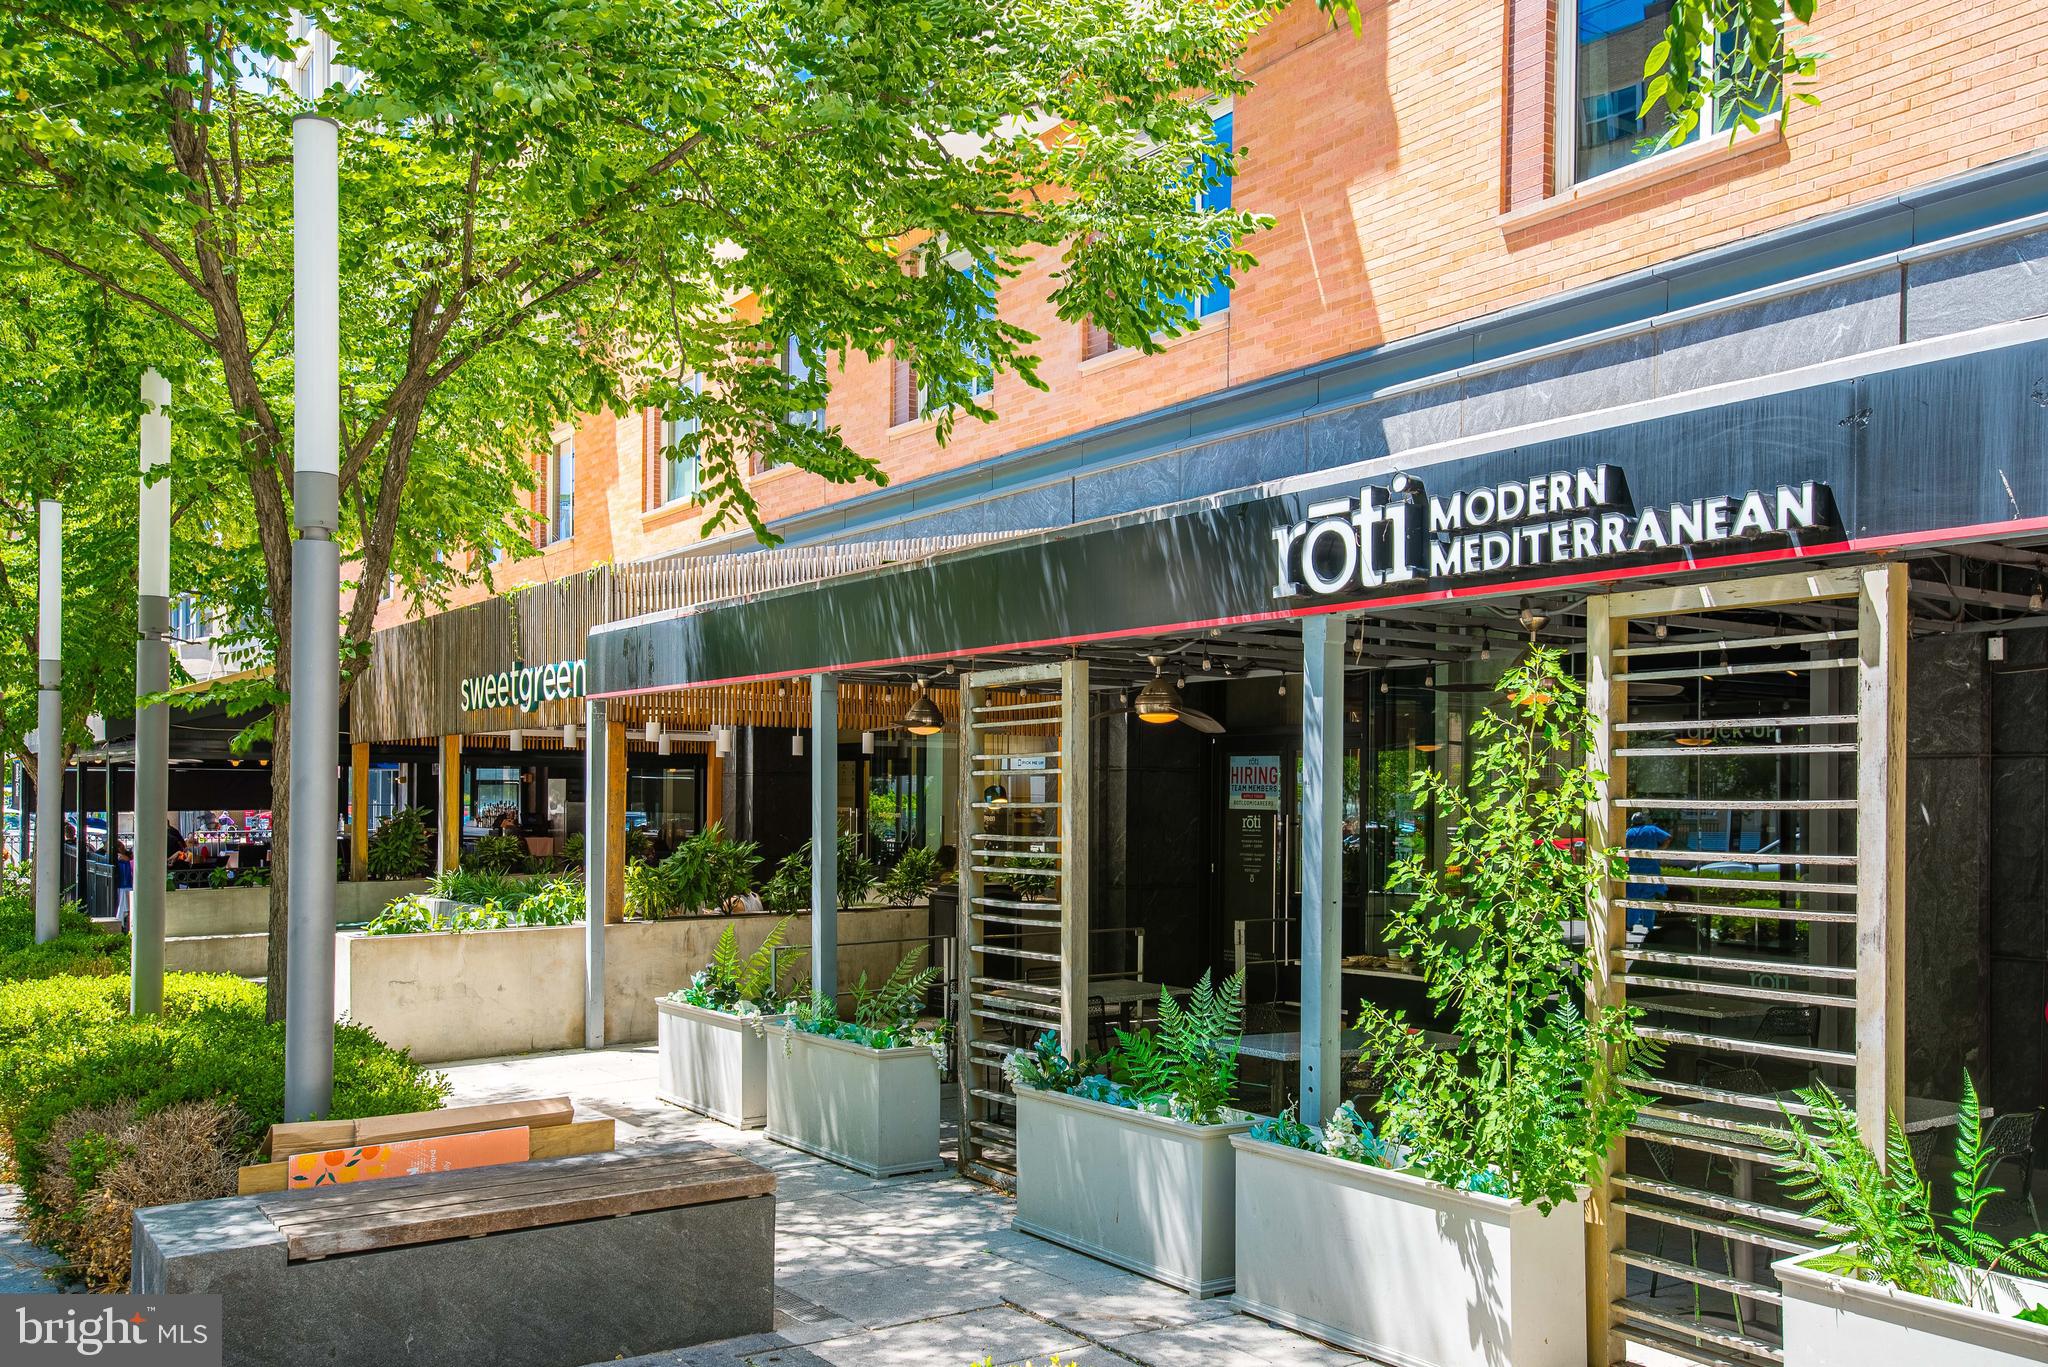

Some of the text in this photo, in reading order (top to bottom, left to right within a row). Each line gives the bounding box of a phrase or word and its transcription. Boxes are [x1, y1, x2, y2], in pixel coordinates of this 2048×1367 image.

[1430, 463, 1609, 533] MODERN
[1430, 481, 1817, 578] MEDITERRANEAN
[460, 659, 587, 713] sweetgreen
[1231, 766, 1278, 785] HIRING
